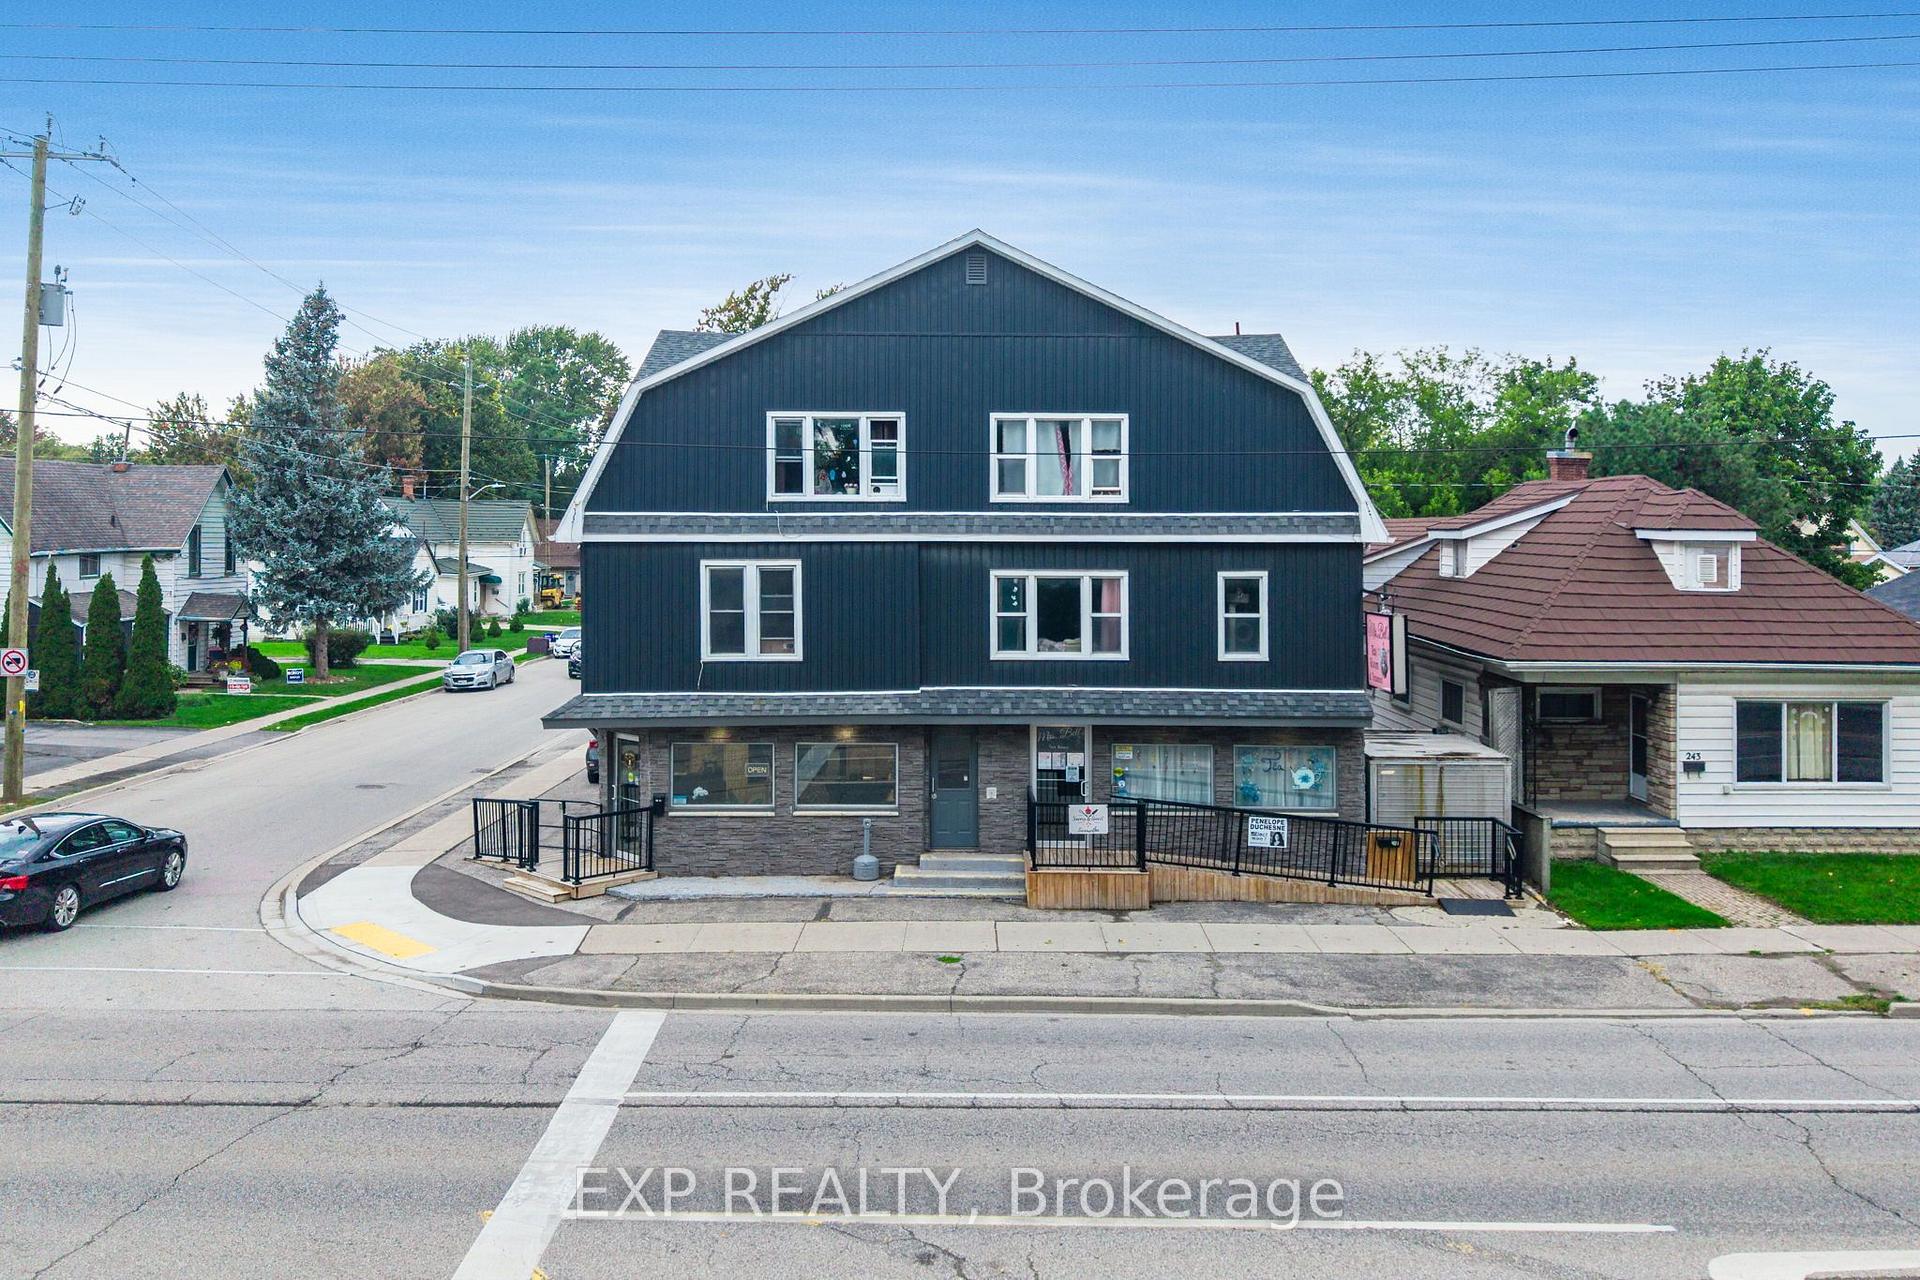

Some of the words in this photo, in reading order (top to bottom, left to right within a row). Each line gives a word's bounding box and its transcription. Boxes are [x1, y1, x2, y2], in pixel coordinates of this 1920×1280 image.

[1685, 752, 1702, 760] 243
[1261, 752, 1285, 772] Tea
[747, 766, 767, 774] OPEN
